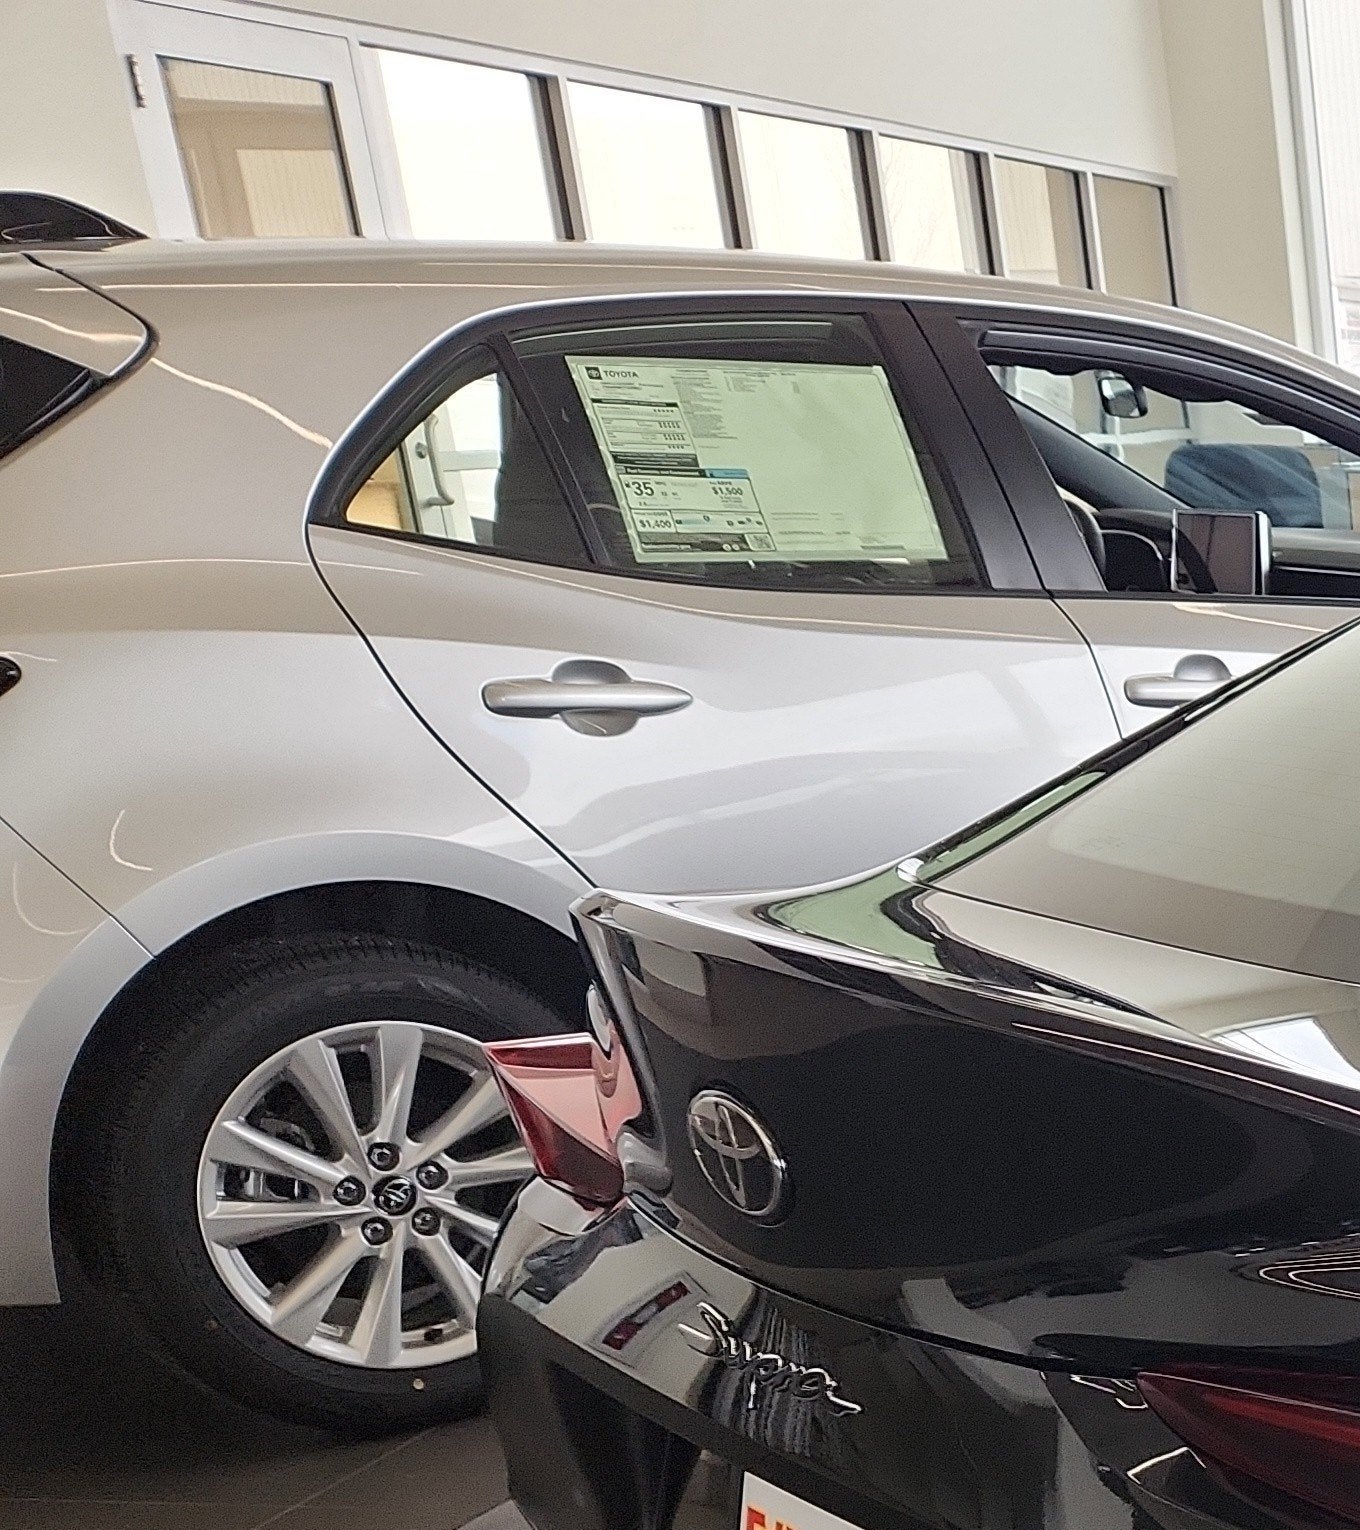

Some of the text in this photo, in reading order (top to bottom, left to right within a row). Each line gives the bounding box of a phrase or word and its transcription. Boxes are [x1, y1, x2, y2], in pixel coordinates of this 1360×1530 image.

[603, 370, 639, 379] TOYOTA
[632, 481, 655, 497] 35
[711, 486, 744, 497] $1,500
[639, 518, 672, 529] $1,400
[678, 1301, 863, 1417] Supra
